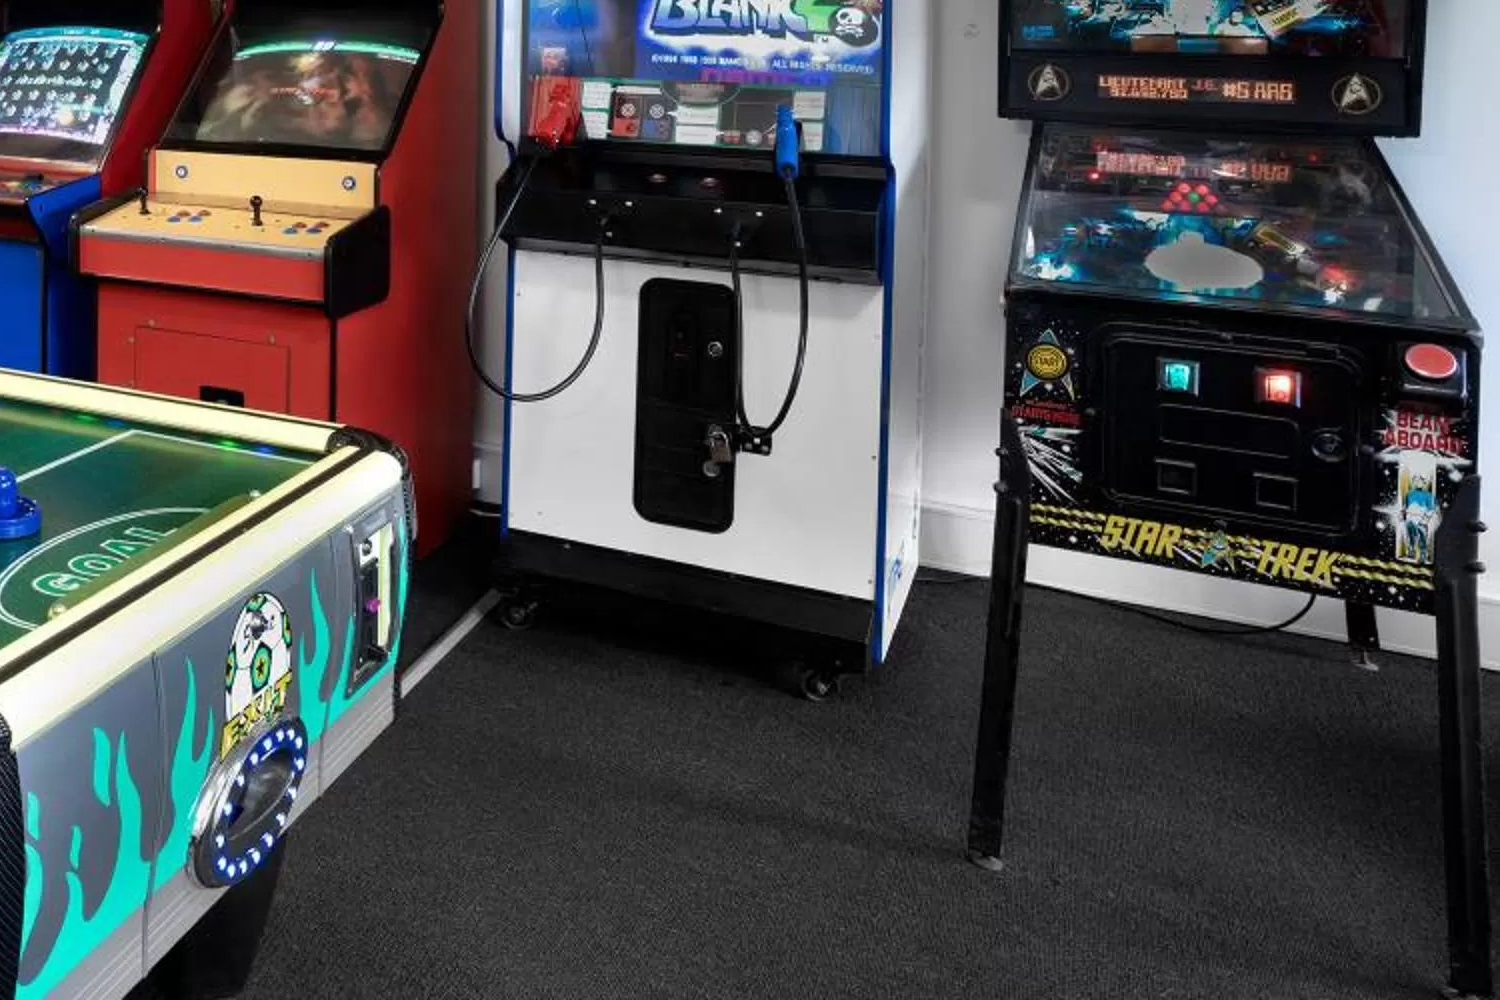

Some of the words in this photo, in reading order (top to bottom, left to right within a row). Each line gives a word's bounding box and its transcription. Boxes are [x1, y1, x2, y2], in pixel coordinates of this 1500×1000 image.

[1383, 427, 1464, 456] ABOARD
[31, 526, 179, 597] GOAL
[1101, 514, 1185, 558] STAR
[1256, 539, 1342, 586] TREK
[220, 668, 292, 764] EXIT
